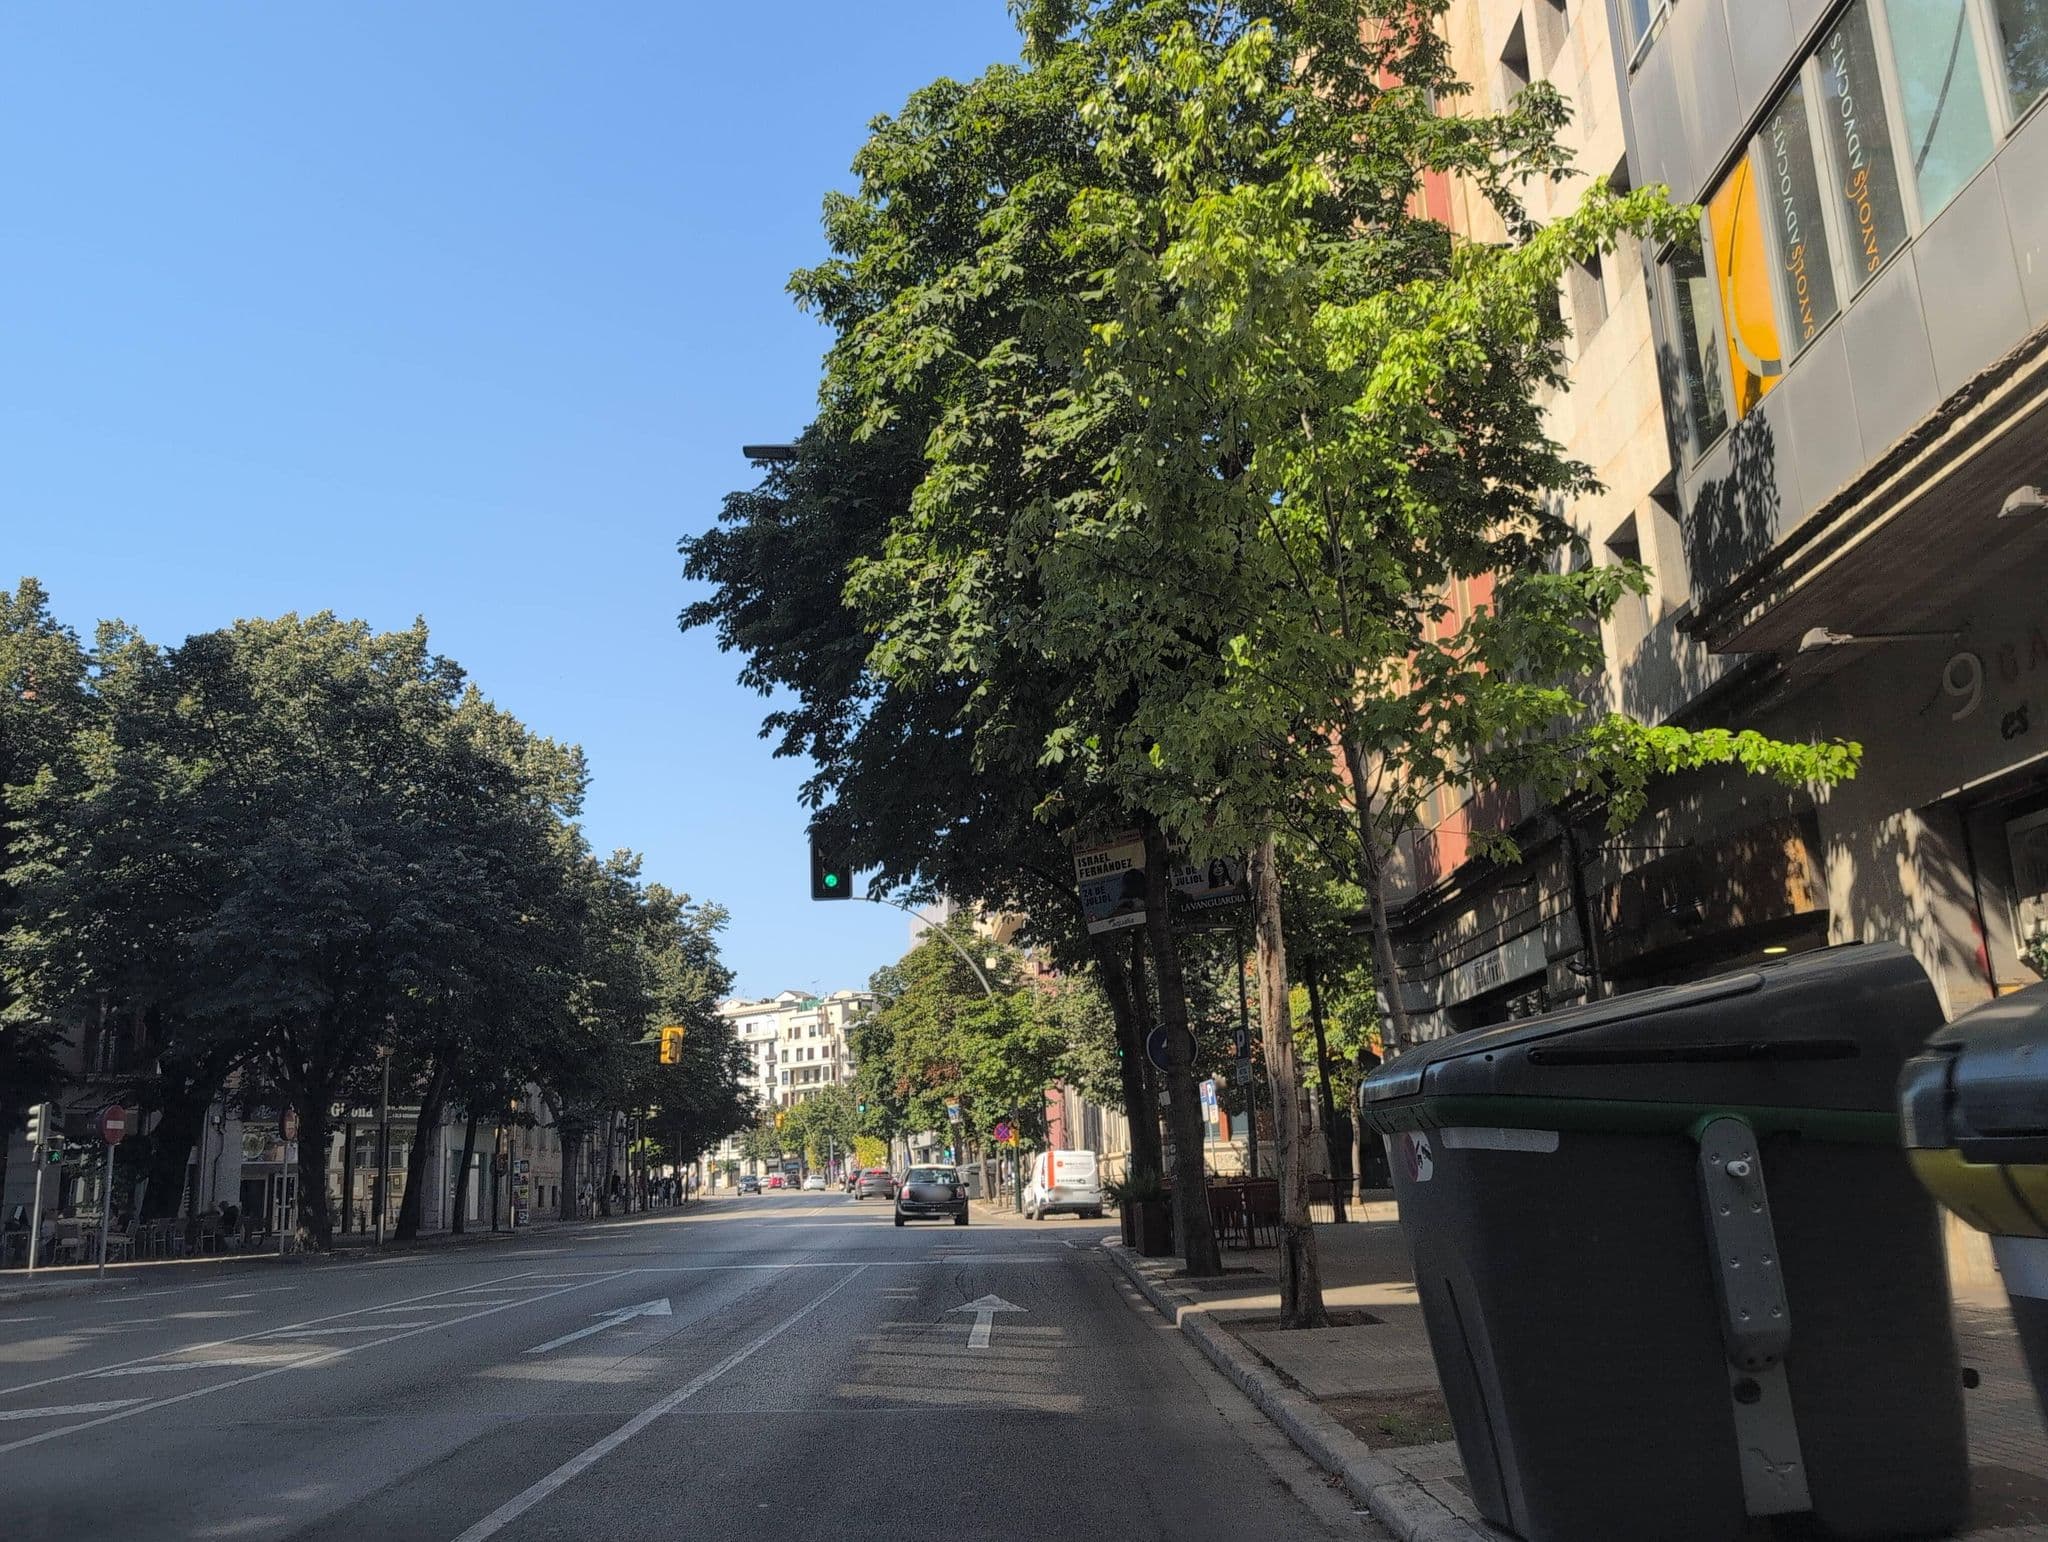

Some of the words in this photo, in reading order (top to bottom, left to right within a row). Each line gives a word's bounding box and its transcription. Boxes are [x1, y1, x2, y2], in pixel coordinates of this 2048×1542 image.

[1831, 32, 1865, 170] ADVOCATS
[1772, 115, 1801, 245] ADVOCATS
[1078, 852, 1111, 868] ISRAEL
[1175, 874, 1203, 887] JULIOL
[1084, 893, 1112, 907] JULIOL
[330, 1102, 374, 1118] Giona
